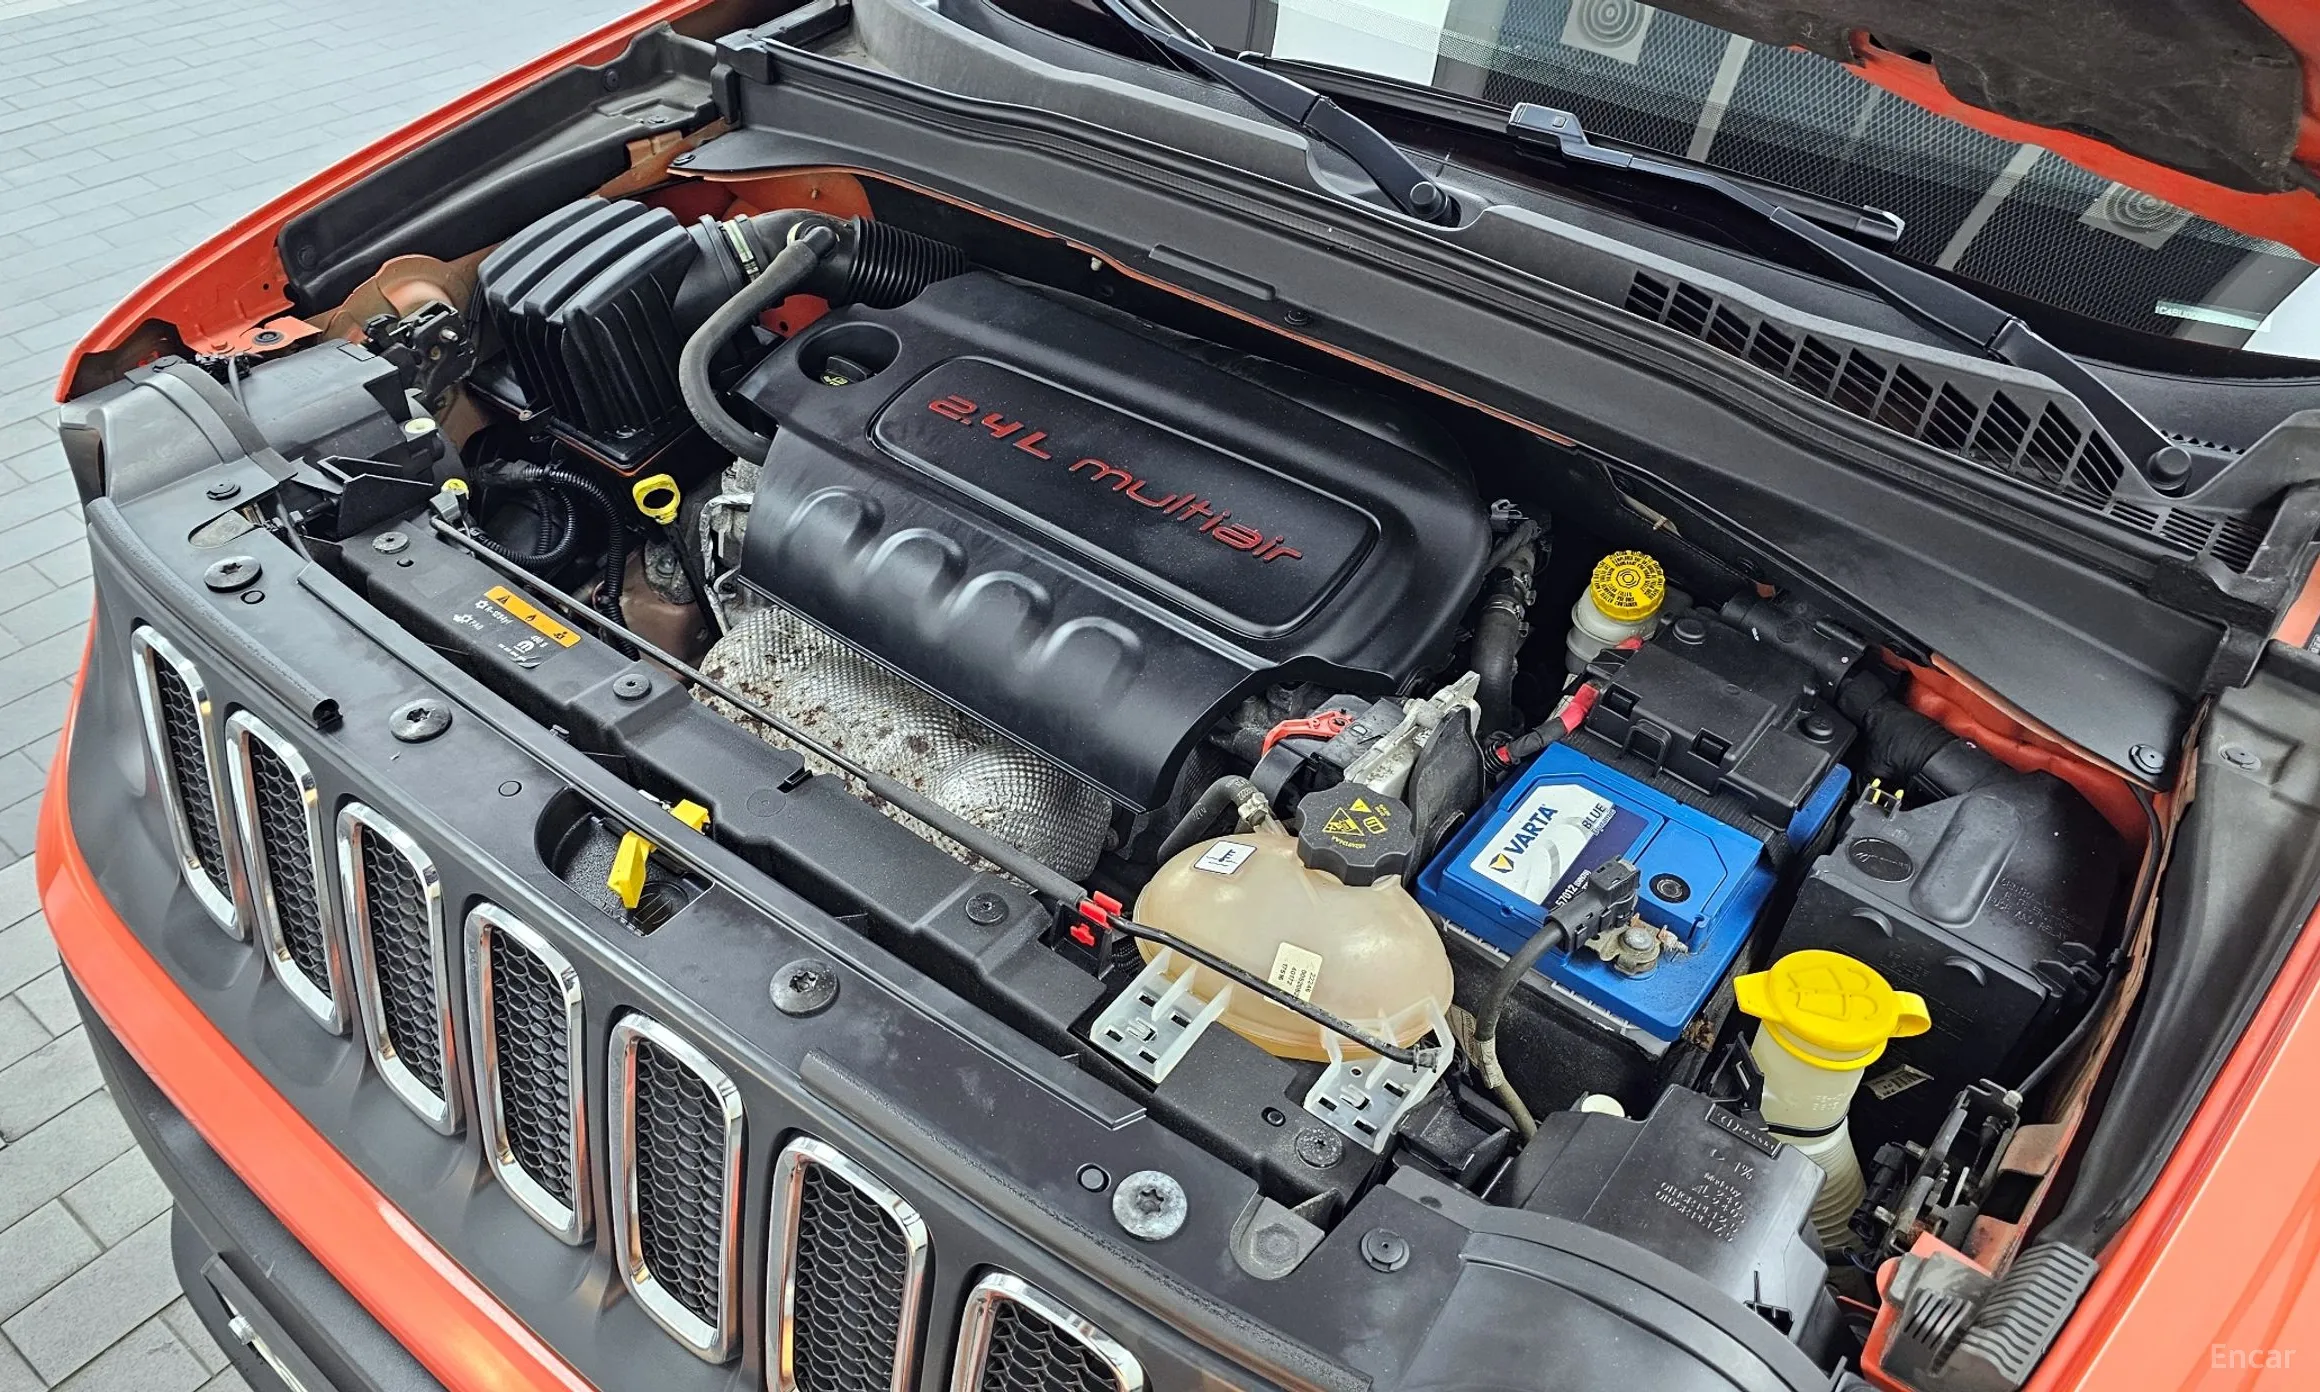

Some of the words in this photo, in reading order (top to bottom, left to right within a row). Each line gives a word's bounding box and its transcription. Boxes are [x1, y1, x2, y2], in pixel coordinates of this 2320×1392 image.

[1069, 458, 1302, 563] multiair
[1503, 804, 1558, 855] VARTA
[1581, 802, 1607, 830] BLUE
[1555, 884, 1578, 907] 57012
